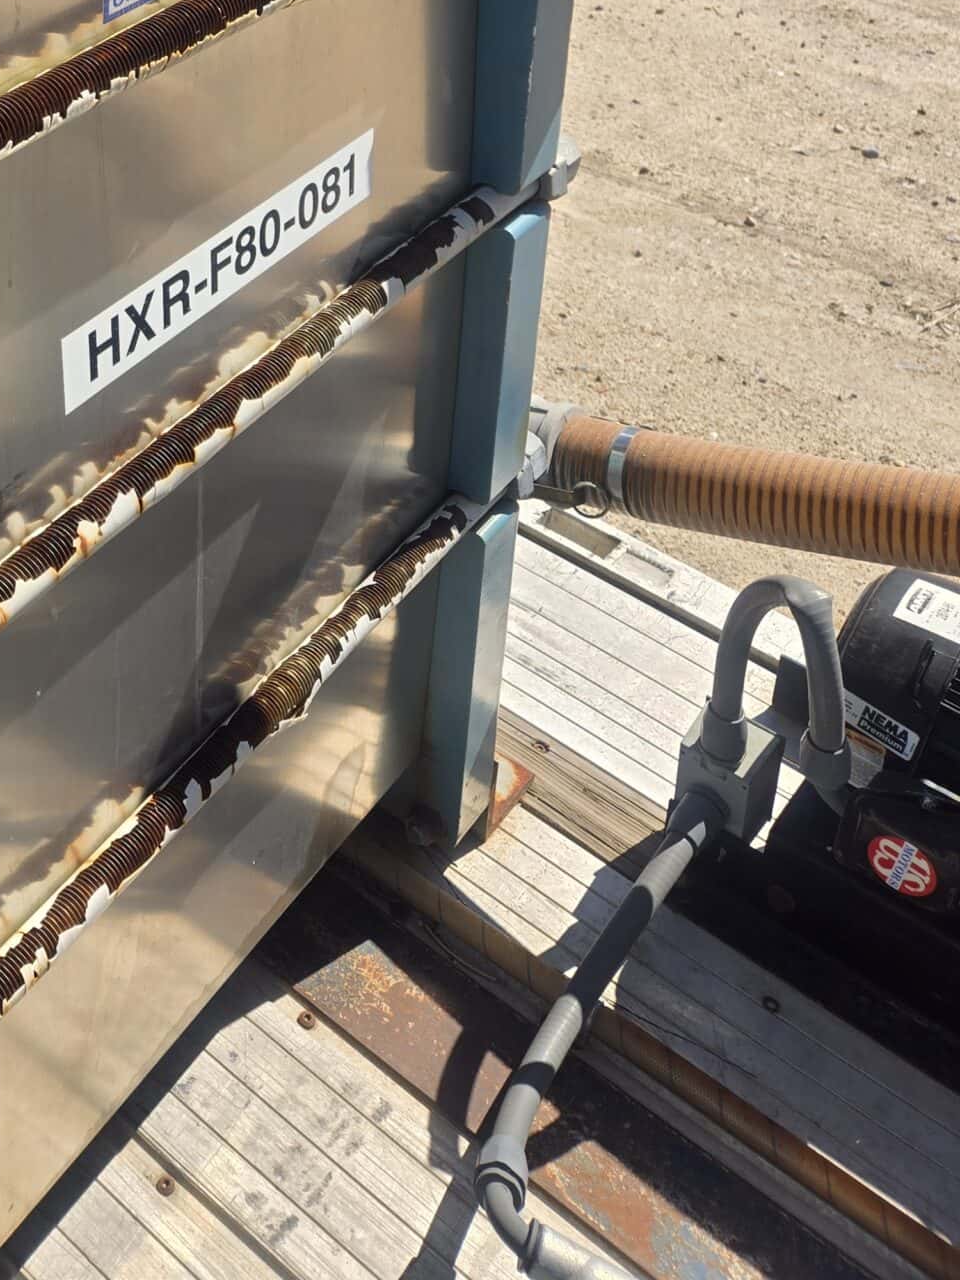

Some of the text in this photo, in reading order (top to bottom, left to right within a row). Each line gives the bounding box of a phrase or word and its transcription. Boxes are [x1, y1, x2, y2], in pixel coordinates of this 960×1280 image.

[87, 153, 356, 382] HXR-F80-081
[859, 720, 903, 751] Premium
[861, 706, 909, 742] NEMA
[887, 843, 917, 889] MOTORS
